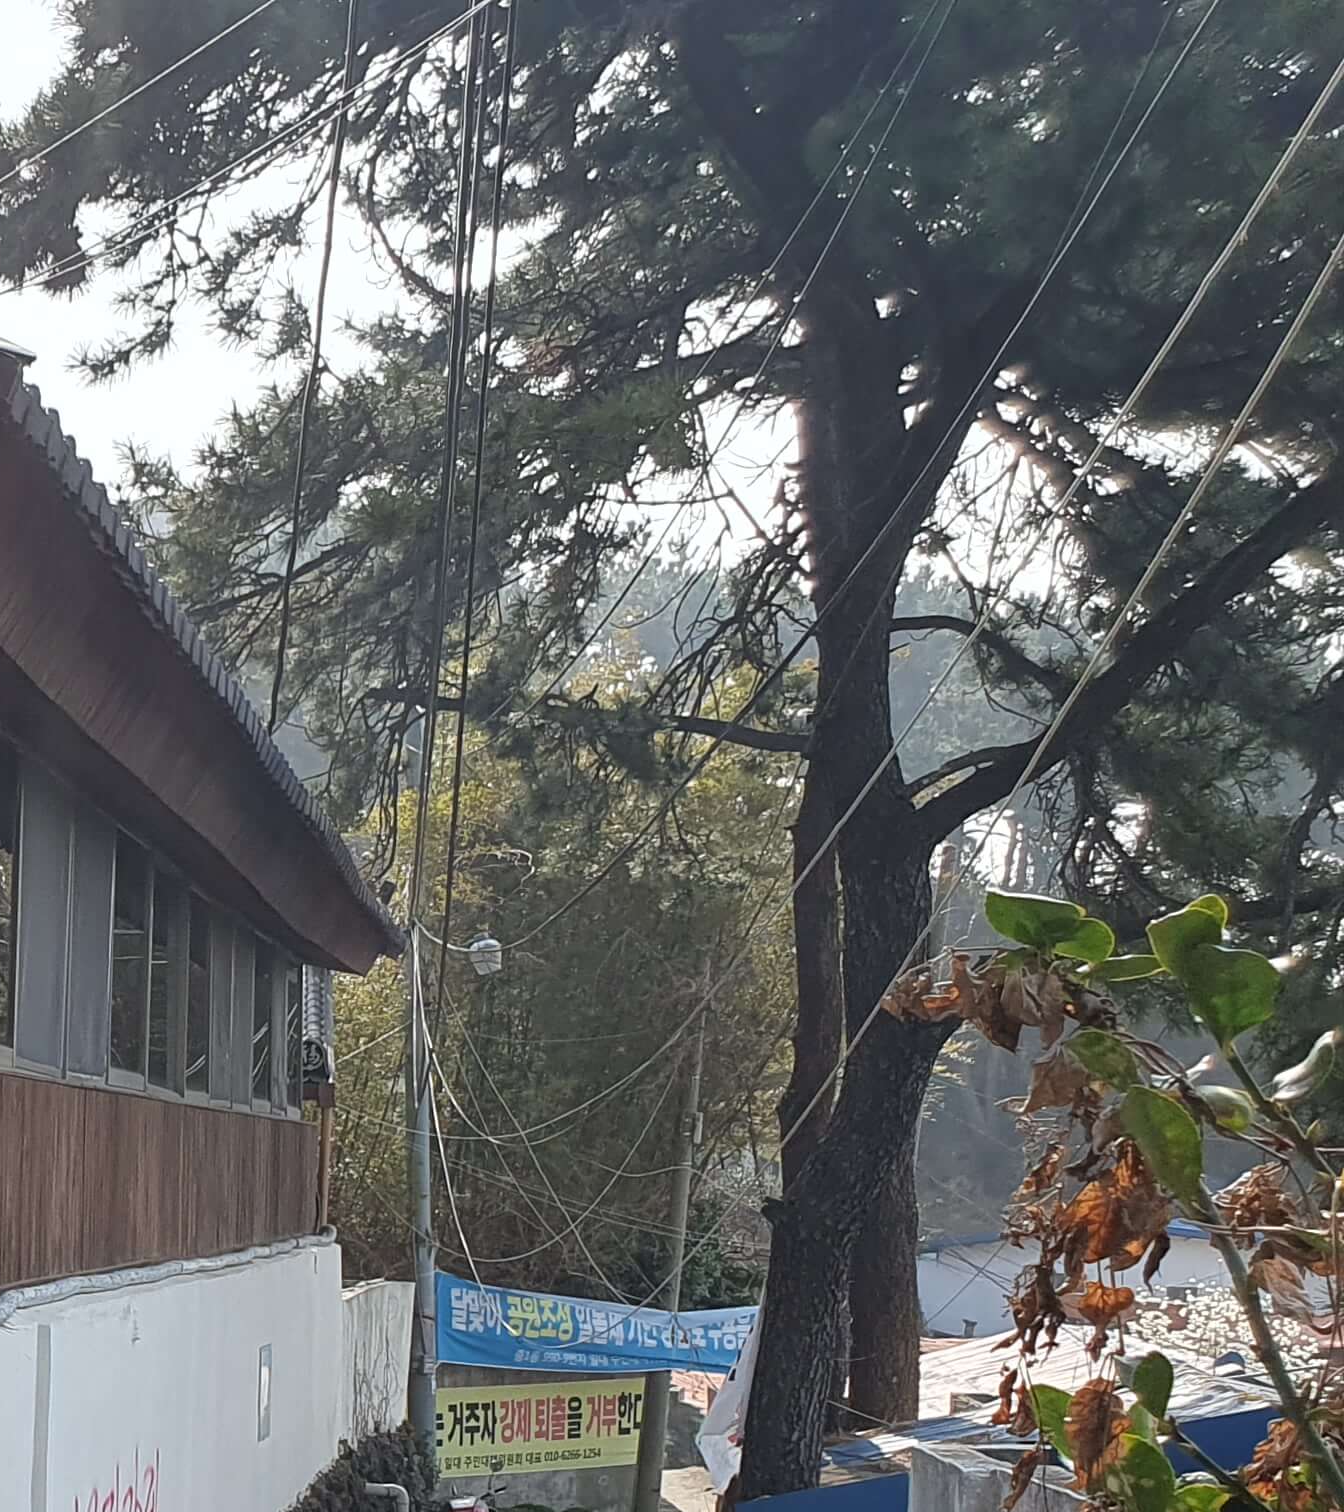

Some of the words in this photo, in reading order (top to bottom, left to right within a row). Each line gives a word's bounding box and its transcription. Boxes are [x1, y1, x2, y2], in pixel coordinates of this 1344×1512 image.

[450, 1287, 503, 1335] 달맞이
[507, 1295, 574, 1342] 공원조성
[447, 1400, 497, 1447] 거주자
[499, 1398, 532, 1444] 강제
[534, 1395, 582, 1441] 퇴출을
